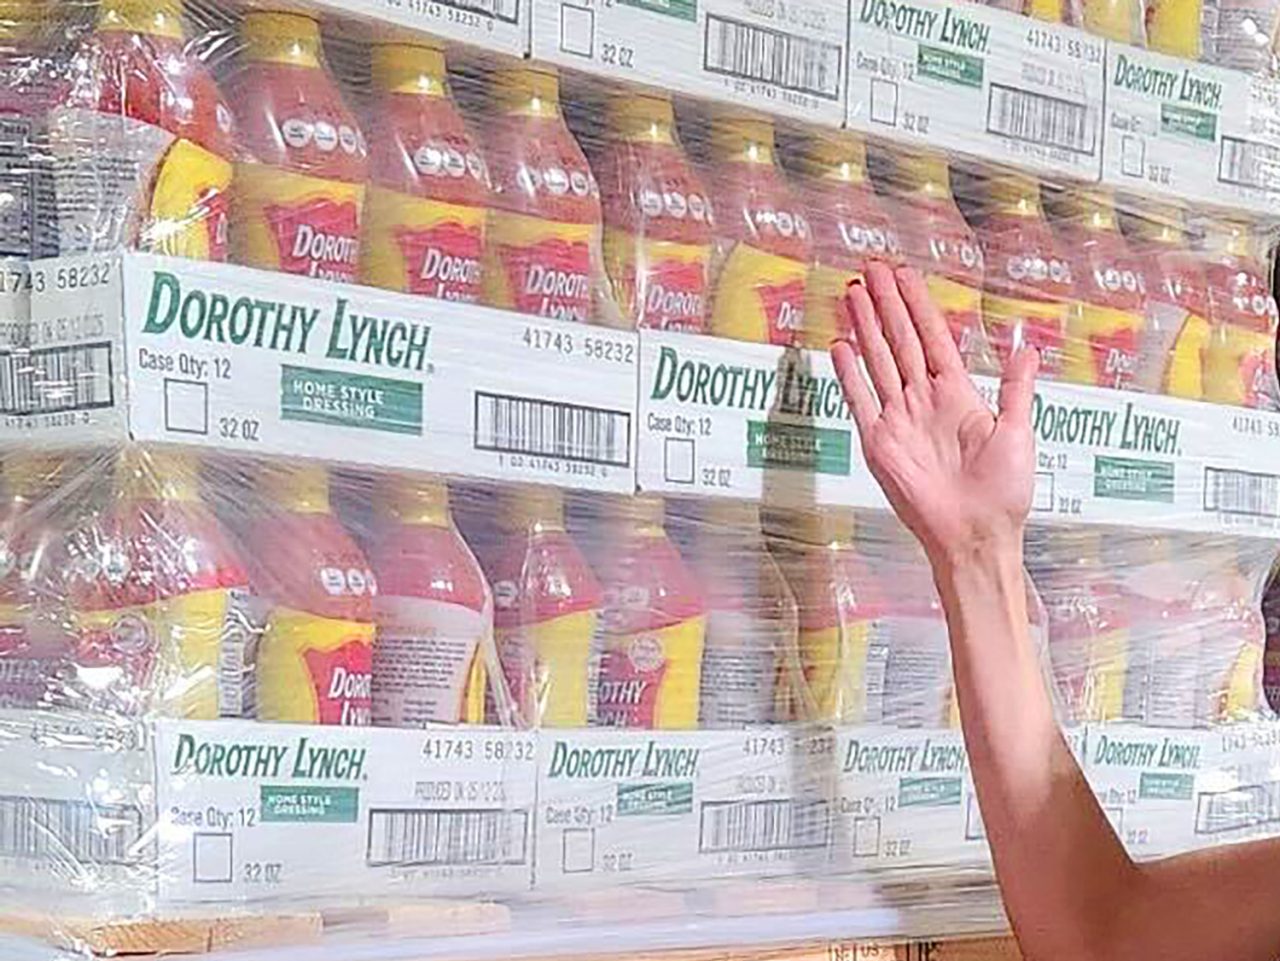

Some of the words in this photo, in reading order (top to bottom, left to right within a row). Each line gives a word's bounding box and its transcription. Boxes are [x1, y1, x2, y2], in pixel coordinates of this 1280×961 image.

[860, 0, 936, 45] DOROTHY
[940, 6, 988, 53] LYNCH
[602, 43, 619, 65] 32
[1113, 54, 1178, 99] DOROTHY
[1178, 68, 1221, 106] LYNCH
[0, 269, 45, 294] 1743
[57, 262, 110, 292] 58232
[142, 271, 319, 355] DOROTHY
[326, 298, 431, 372] LYNCH
[522, 328, 574, 355] 41743
[584, 333, 634, 363] 58232
[139, 348, 174, 373] Case
[177, 355, 209, 378] Qty:
[213, 359, 232, 379] 12
[650, 346, 777, 411] DOROTHY
[293, 380, 336, 399] HOME
[341, 385, 384, 405] STYLE
[303, 397, 375, 417] DRESSING
[219, 417, 239, 438] 32
[241, 420, 260, 441] OZ
[647, 413, 672, 432] Case
[675, 416, 698, 435] Qty:
[699, 418, 712, 436] 12
[1032, 393, 1117, 447] DOROTHY
[1119, 402, 1178, 454] LYNCH
[702, 468, 718, 486] 32
[329, 667, 372, 699] DORO
[171, 734, 288, 778] DOROTHY
[291, 737, 365, 780] LYNCH
[423, 740, 473, 761] 41743
[549, 741, 639, 778] DOROTHY
[641, 740, 698, 777] LYNCH
[742, 738, 784, 755] 41743
[843, 738, 918, 773] DOROTHY
[920, 738, 967, 770] LYNCH
[1094, 736, 1157, 766] DOROTHY
[207, 807, 234, 827] Qty:
[238, 808, 255, 826] 12
[600, 805, 615, 822] 12
[243, 863, 262, 882] 32
